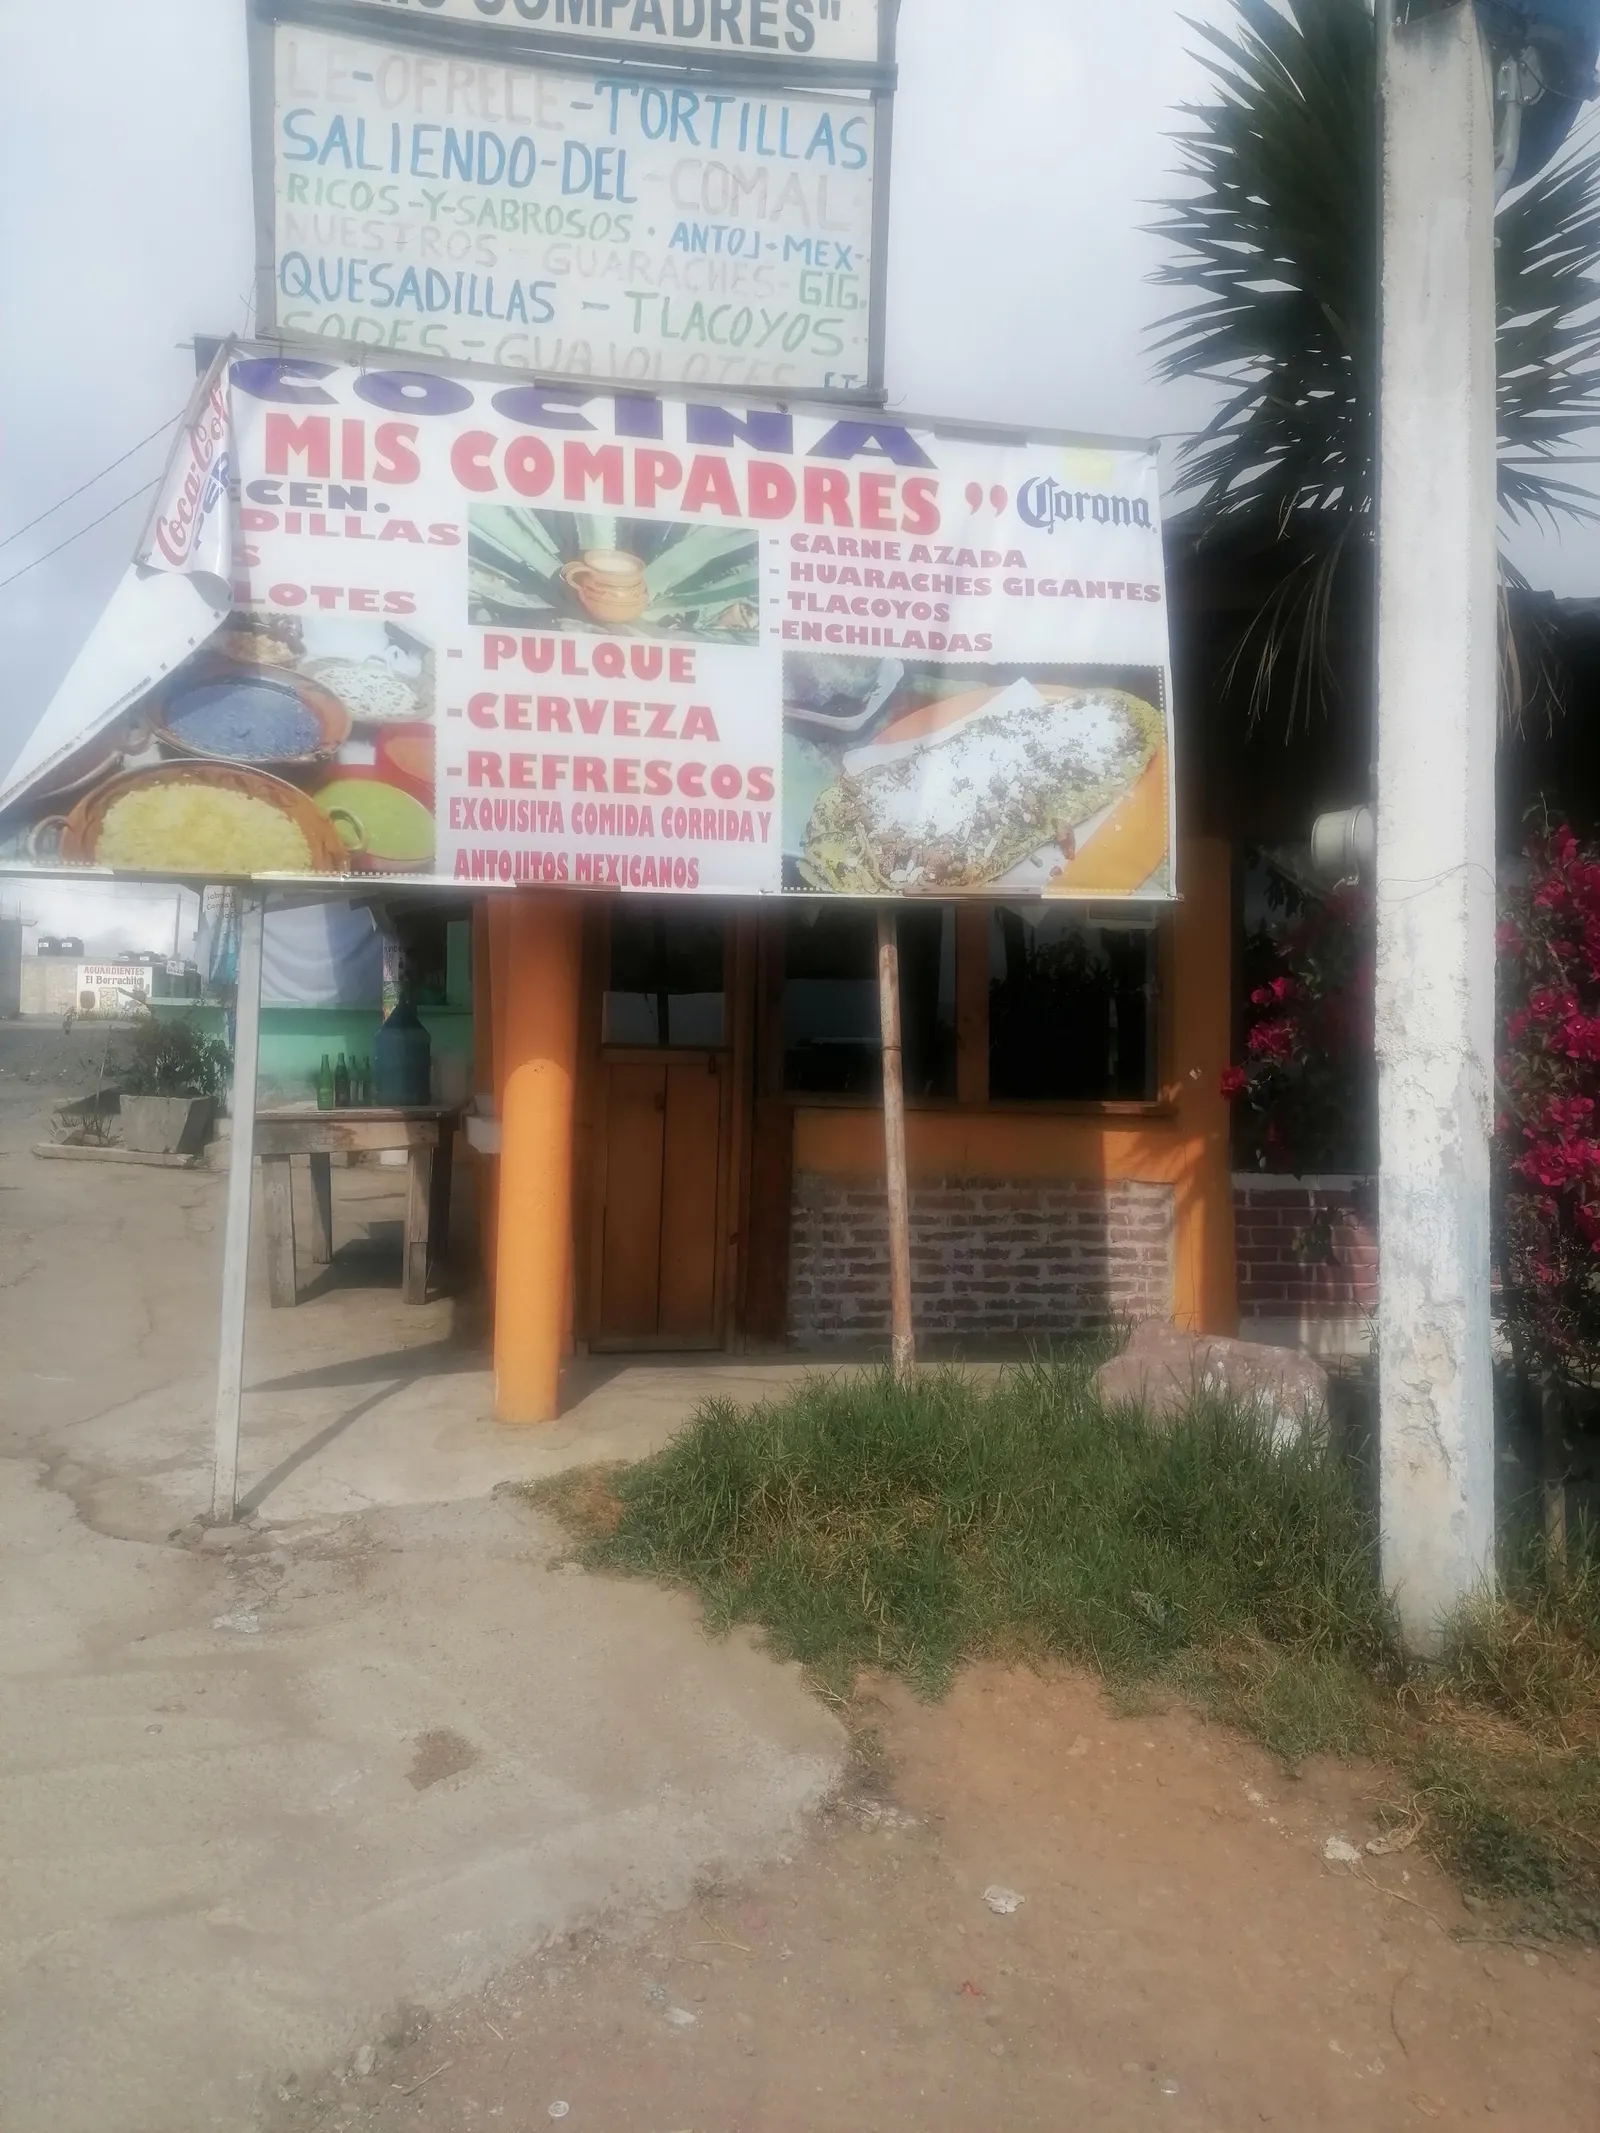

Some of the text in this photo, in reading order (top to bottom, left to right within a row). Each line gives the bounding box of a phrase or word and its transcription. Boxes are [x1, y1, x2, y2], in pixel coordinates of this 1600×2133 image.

[277, 251, 845, 357] QUESADILLAS TLACOYOS
[230, 357, 938, 469] COCINA
[265, 412, 941, 535] MIS COMPADRES
[1017, 476, 1155, 534] Corona
[790, 533, 1027, 568] CARNE AZADA
[790, 561, 1162, 603] HUARACHES GIGANTES
[787, 590, 950, 622] TLACOYOS
[483, 633, 696, 684] PULQUE
[449, 797, 772, 843] EXQUISITA COMIDA CORRIDA Y
[453, 848, 700, 889] ANTOJITOS MEXICANOS
[84, 966, 145, 976] AGUARDIENTES
[85, 976, 144, 985] El Borrachito
